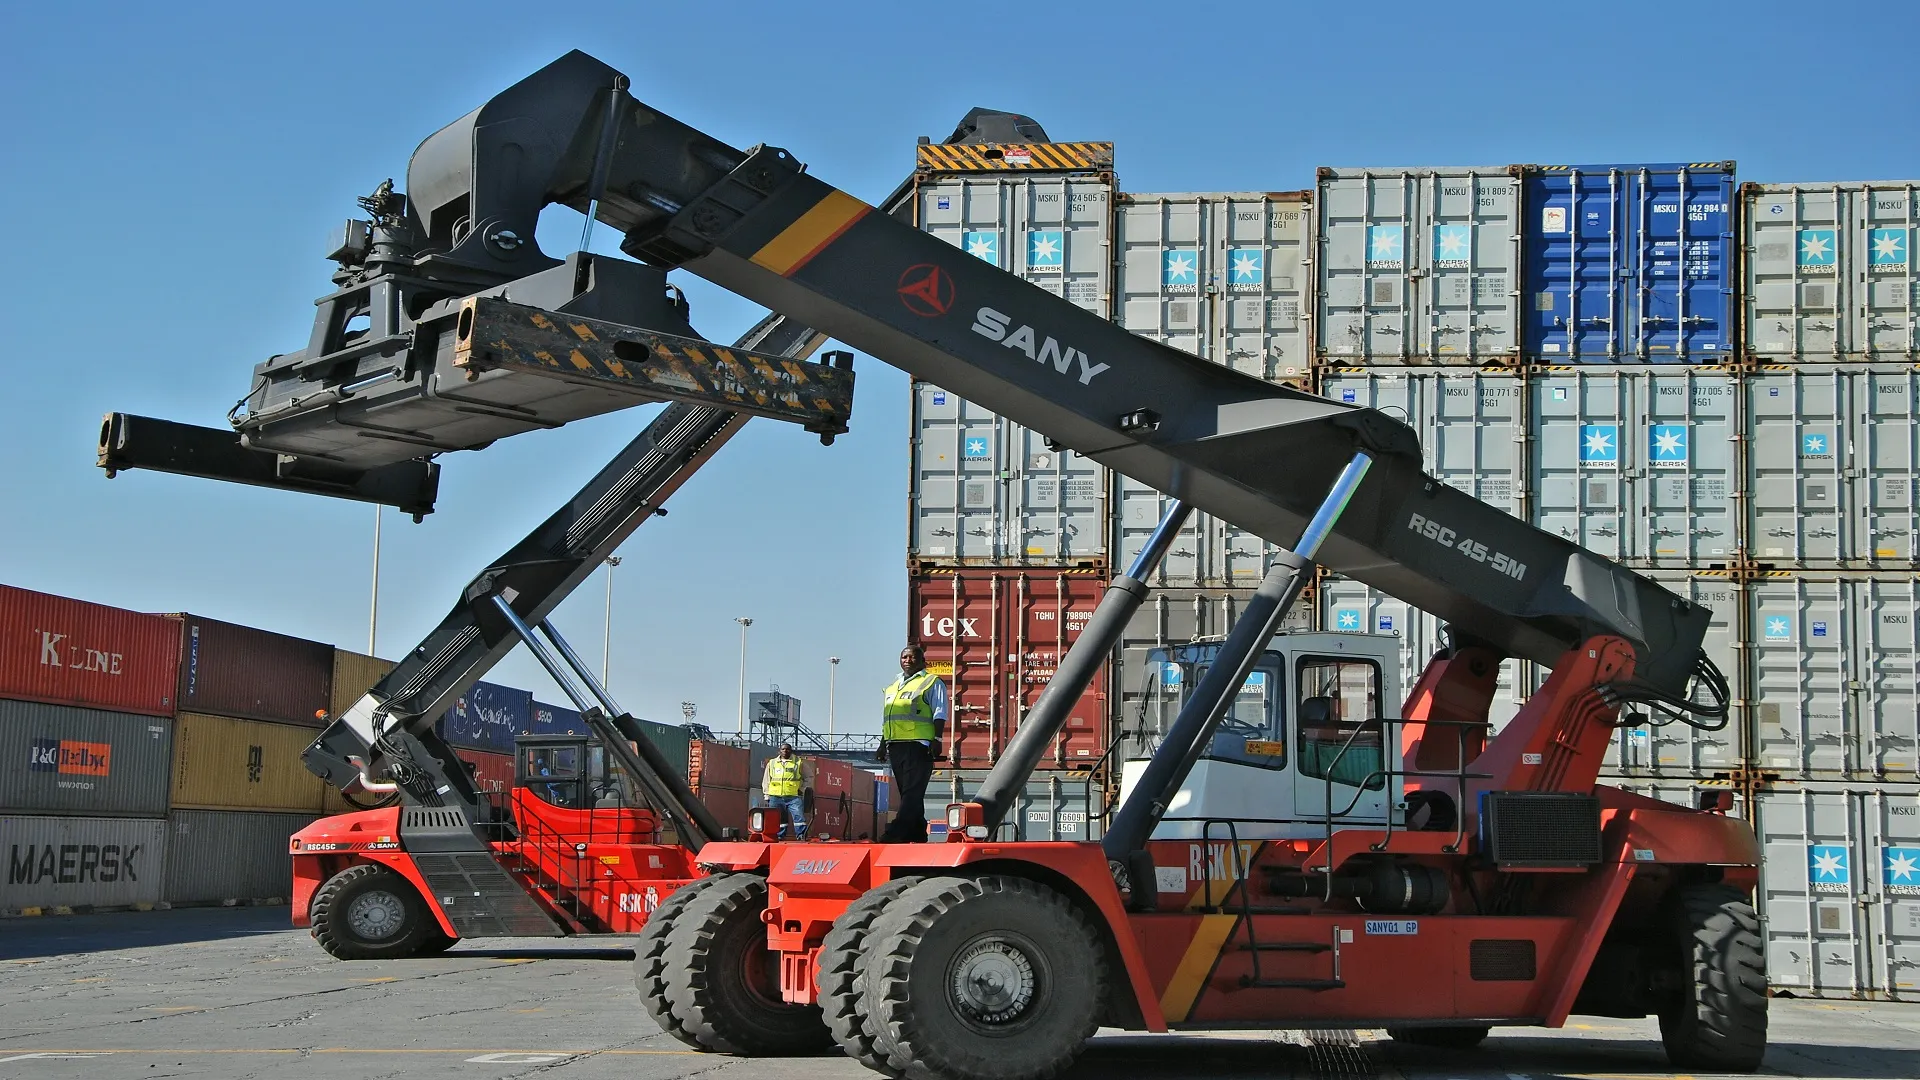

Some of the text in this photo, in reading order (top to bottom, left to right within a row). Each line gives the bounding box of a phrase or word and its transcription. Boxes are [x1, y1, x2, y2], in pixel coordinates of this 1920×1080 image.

[1445, 187, 1467, 196] MSKU
[1476, 187, 1491, 196] 891
[1493, 187, 1507, 195] 809
[1037, 194, 1059, 202] MSKU
[1068, 194, 1082, 202] 024
[1083, 194, 1097, 202] 505
[1476, 198, 1495, 206] 45G1
[1067, 204, 1086, 212] 45G1
[1653, 204, 1677, 213] MSKU
[1687, 205, 1702, 213] 042
[1704, 205, 1719, 213] 984
[1879, 201, 1902, 210] MSKU
[1238, 213, 1259, 221] MSKU
[1268, 213, 1283, 221] 877
[1284, 213, 1299, 221] 669
[1687, 213, 1707, 221] 45G1
[1268, 221, 1287, 229] 45G1
[971, 306, 1111, 386] SANY
[1447, 388, 1468, 396] MSKU
[1479, 388, 1493, 396] 070
[1496, 388, 1511, 396] 771
[1660, 387, 1683, 396] MSKU
[1692, 387, 1707, 396] 977
[1708, 387, 1722, 396] 005
[1481, 399, 1498, 407] 45G1
[1692, 398, 1711, 406] 45G1
[1408, 512, 1527, 581] RSC 45-5M
[1712, 593, 1726, 601] 155
[1035, 611, 1093, 621] TGHU 798909
[1302, 611, 1307, 619] 8
[1883, 615, 1907, 623] MSKU
[1065, 622, 1084, 631] 45G1
[70, 646, 123, 675] LINE
[31, 746, 57, 764] P&O
[1891, 806, 1916, 815] MSKU
[1029, 812, 1048, 821] PONU
[1057, 812, 1085, 821] 766091
[1057, 823, 1076, 832] 45G1
[307, 843, 336, 851] RSC45C
[8, 844, 140, 885] MAERSK
[1189, 843, 1226, 881] RSK
[791, 859, 841, 875] SANY
[619, 893, 642, 913] RSK
[1366, 922, 1417, 933] SANY01 GP
